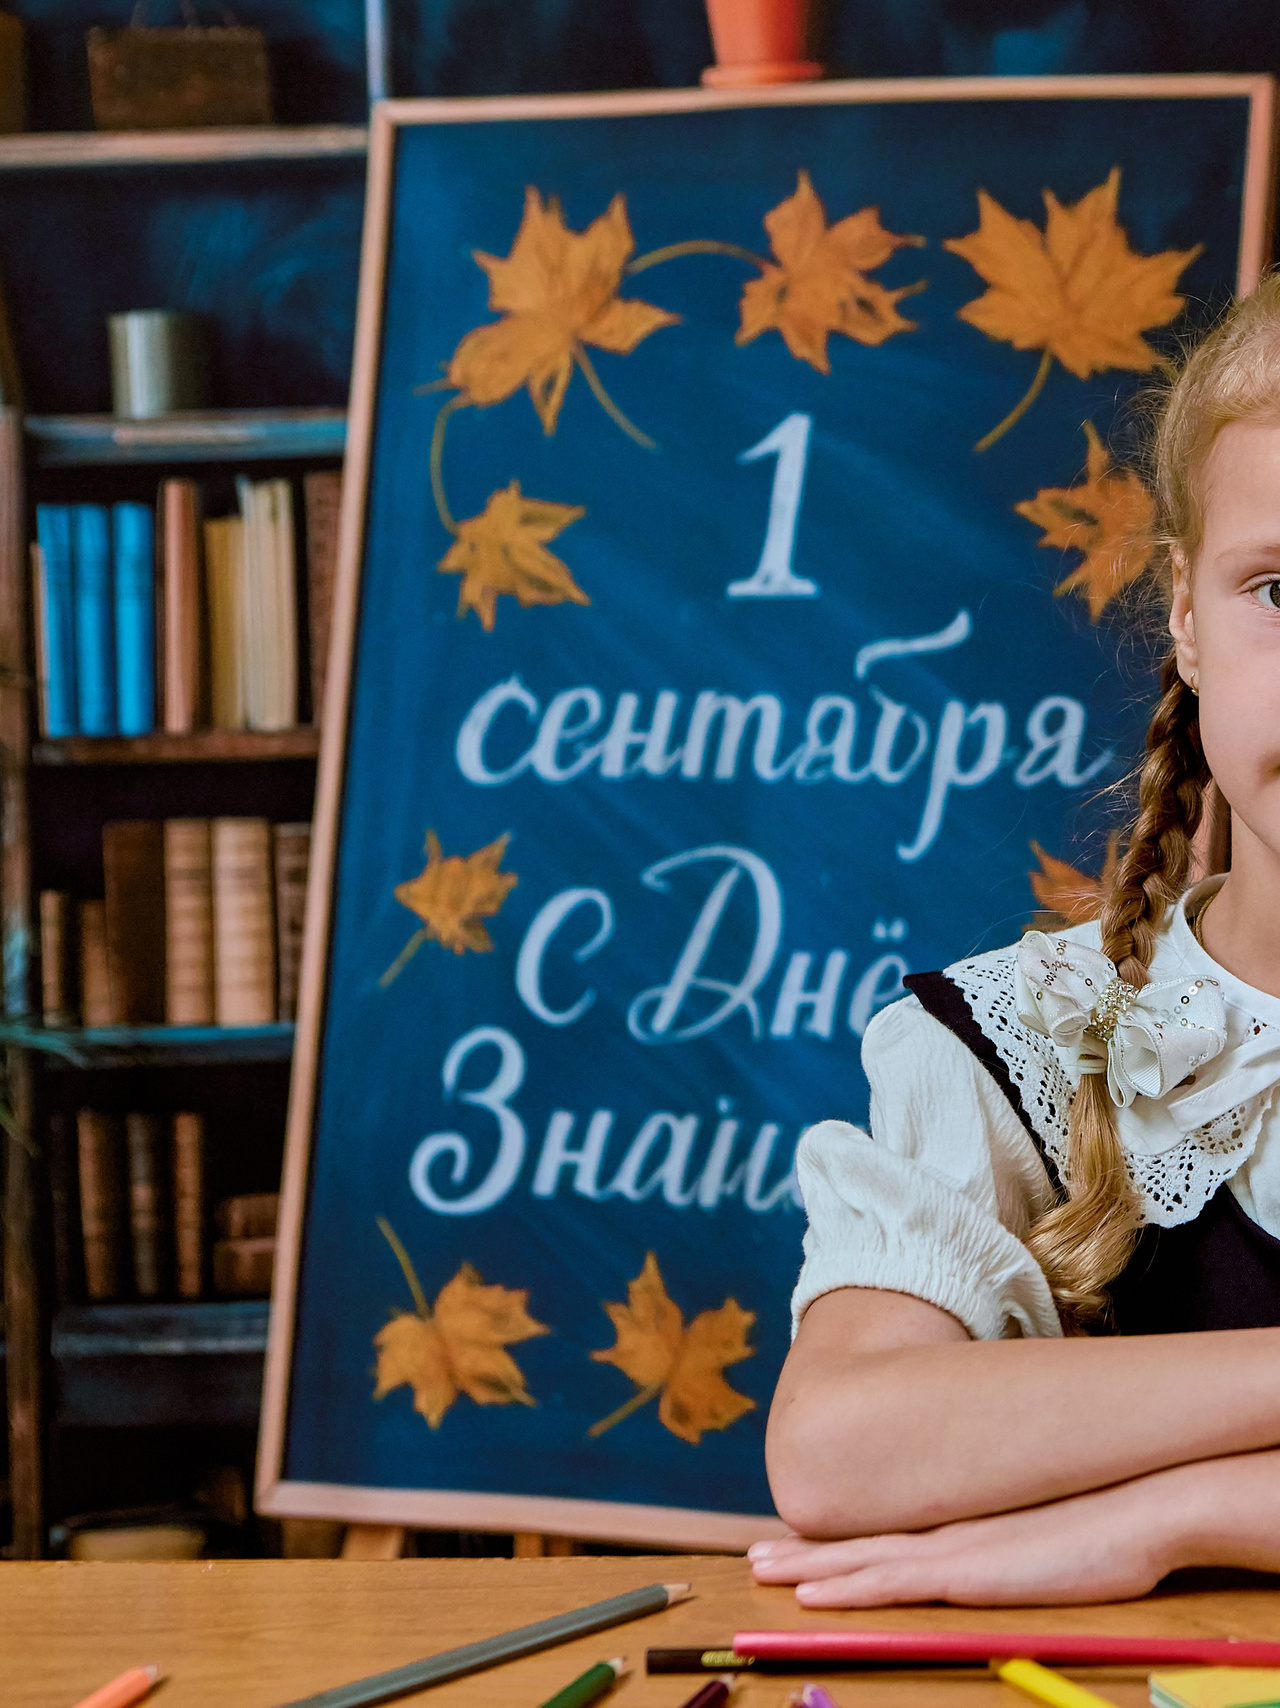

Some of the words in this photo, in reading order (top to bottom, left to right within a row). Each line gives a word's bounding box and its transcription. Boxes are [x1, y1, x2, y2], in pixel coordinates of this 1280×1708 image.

[727, 413, 819, 598] 1
[455, 609, 1113, 861] сентября
[627, 842, 912, 1047] Днё
